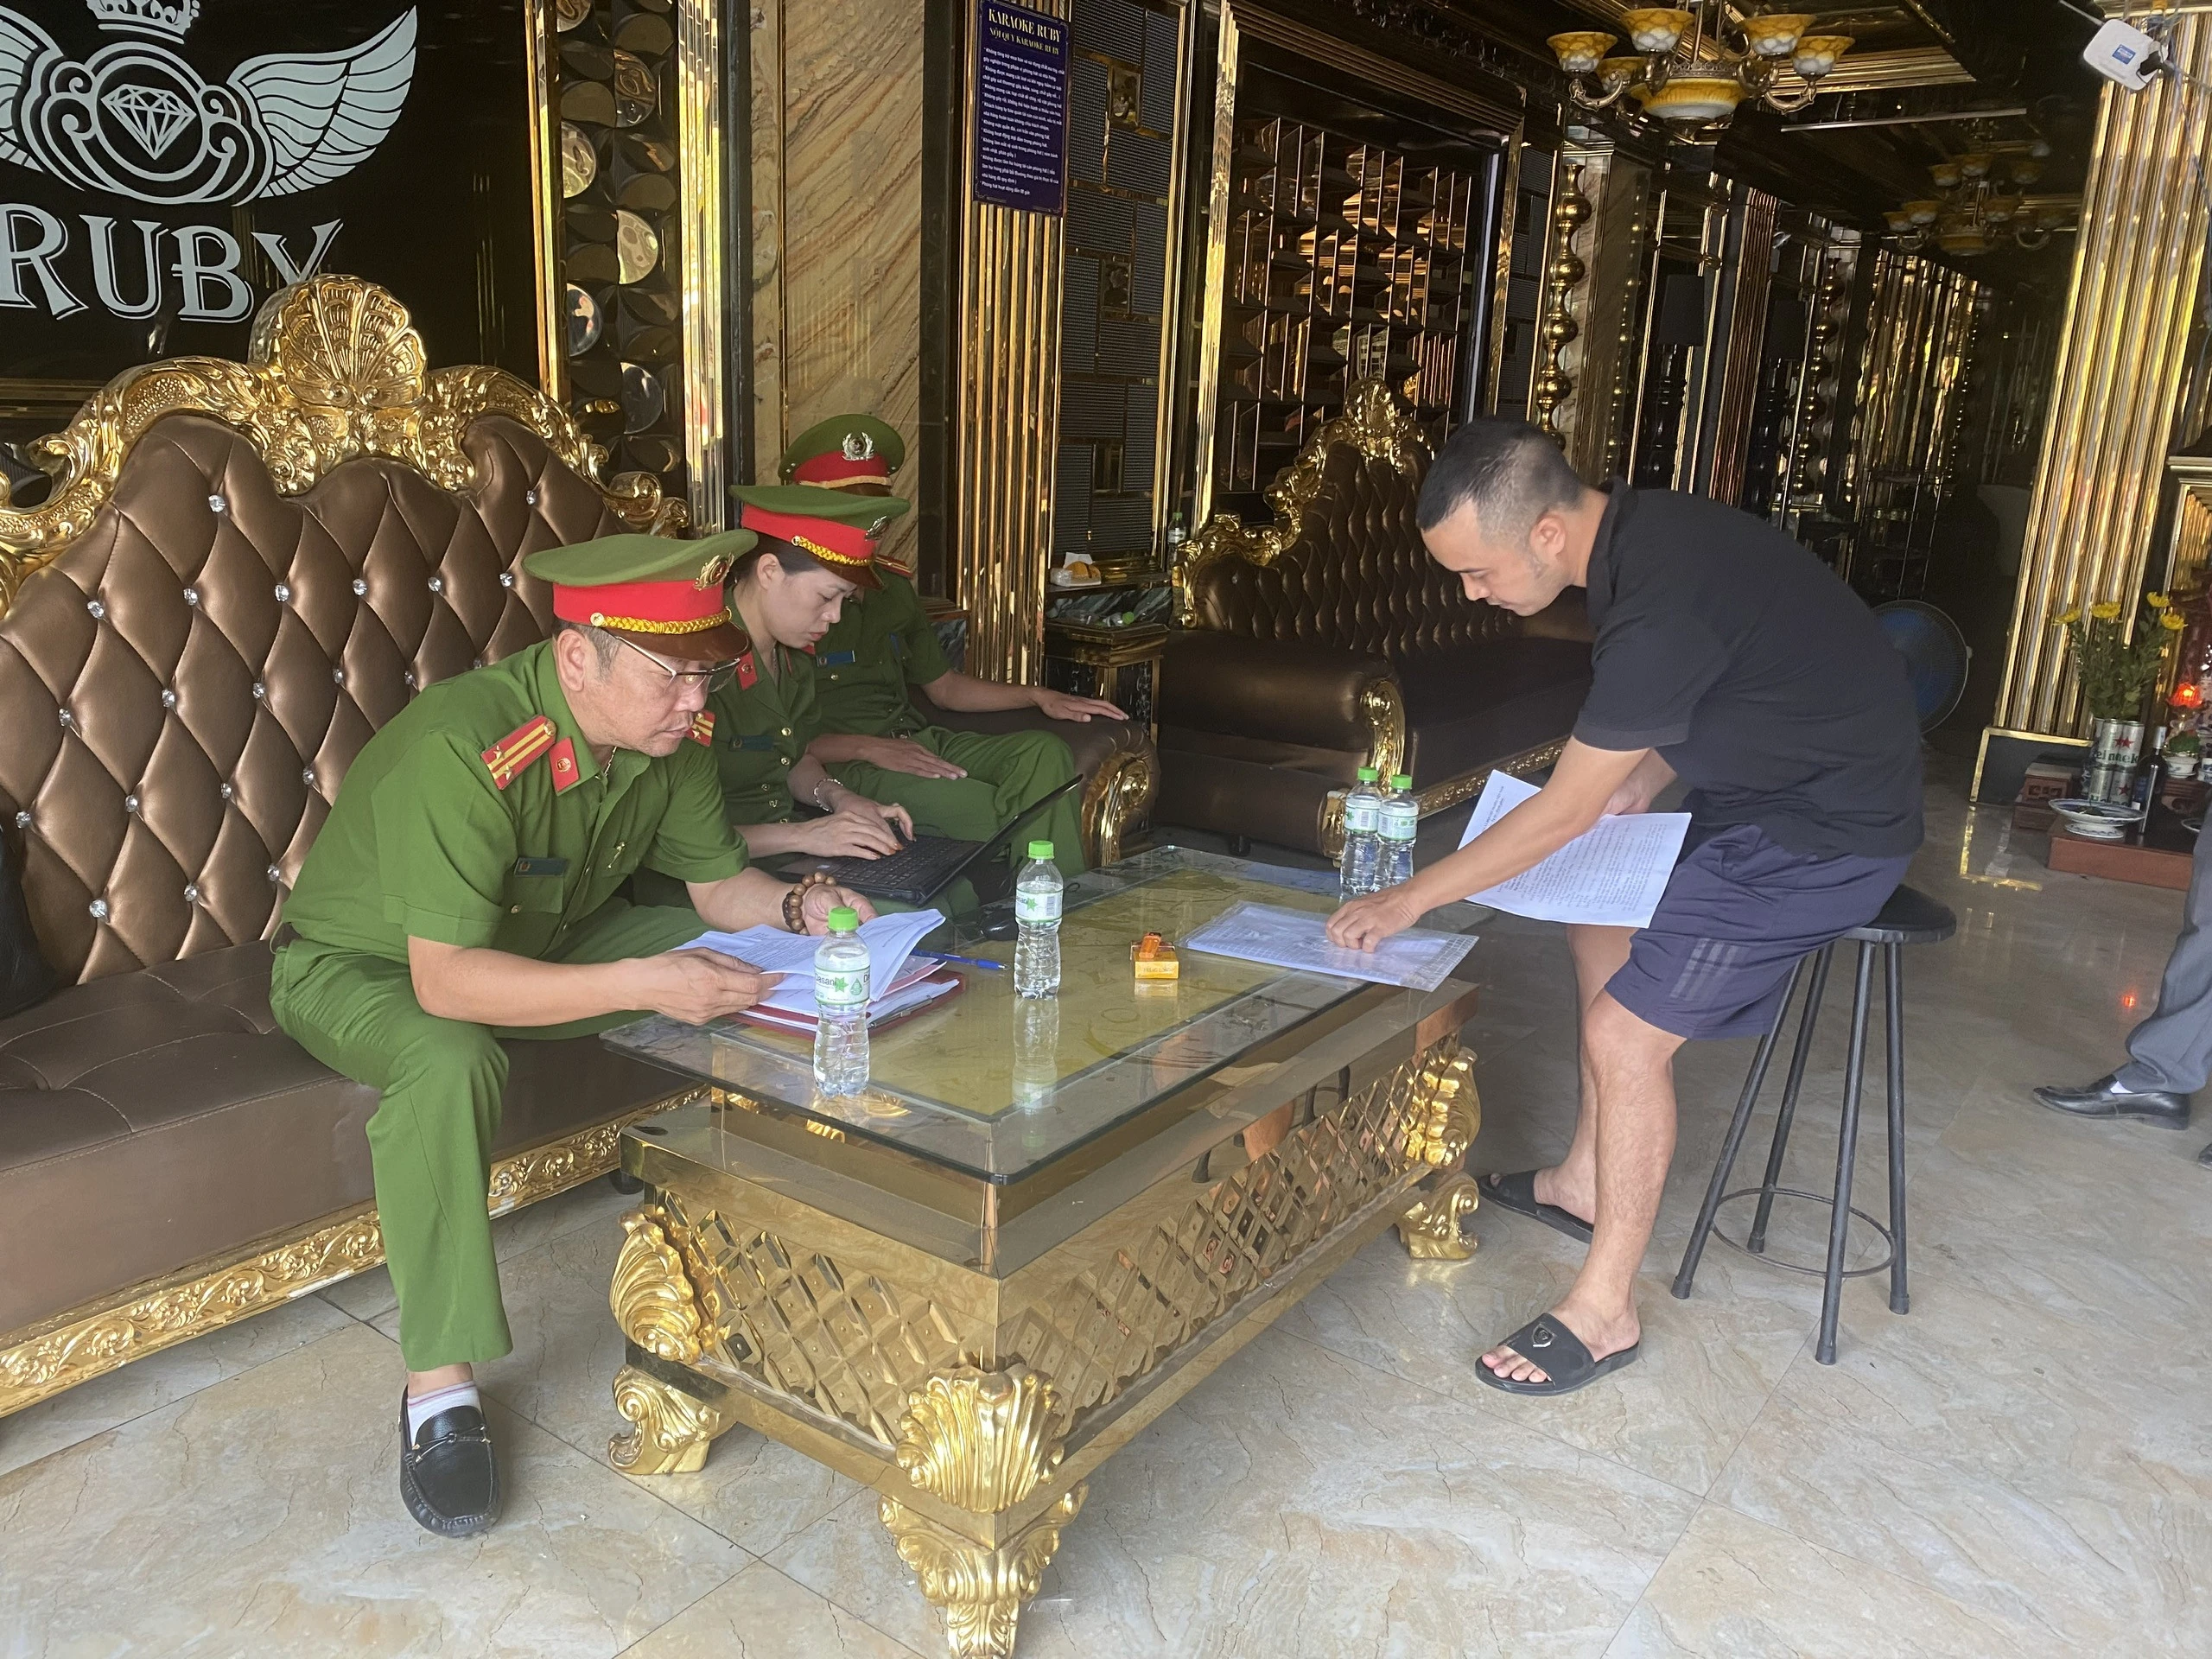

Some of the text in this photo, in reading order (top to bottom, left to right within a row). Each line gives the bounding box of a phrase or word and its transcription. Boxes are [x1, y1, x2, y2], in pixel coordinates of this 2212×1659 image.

[988, 8, 1061, 42] KARAOKE RUBY
[1001, 32, 1015, 42] QUY
[1016, 35, 1045, 51] KARAOKE
[1045, 44, 1059, 55] RUBY
[0, 203, 344, 323] RUBY
